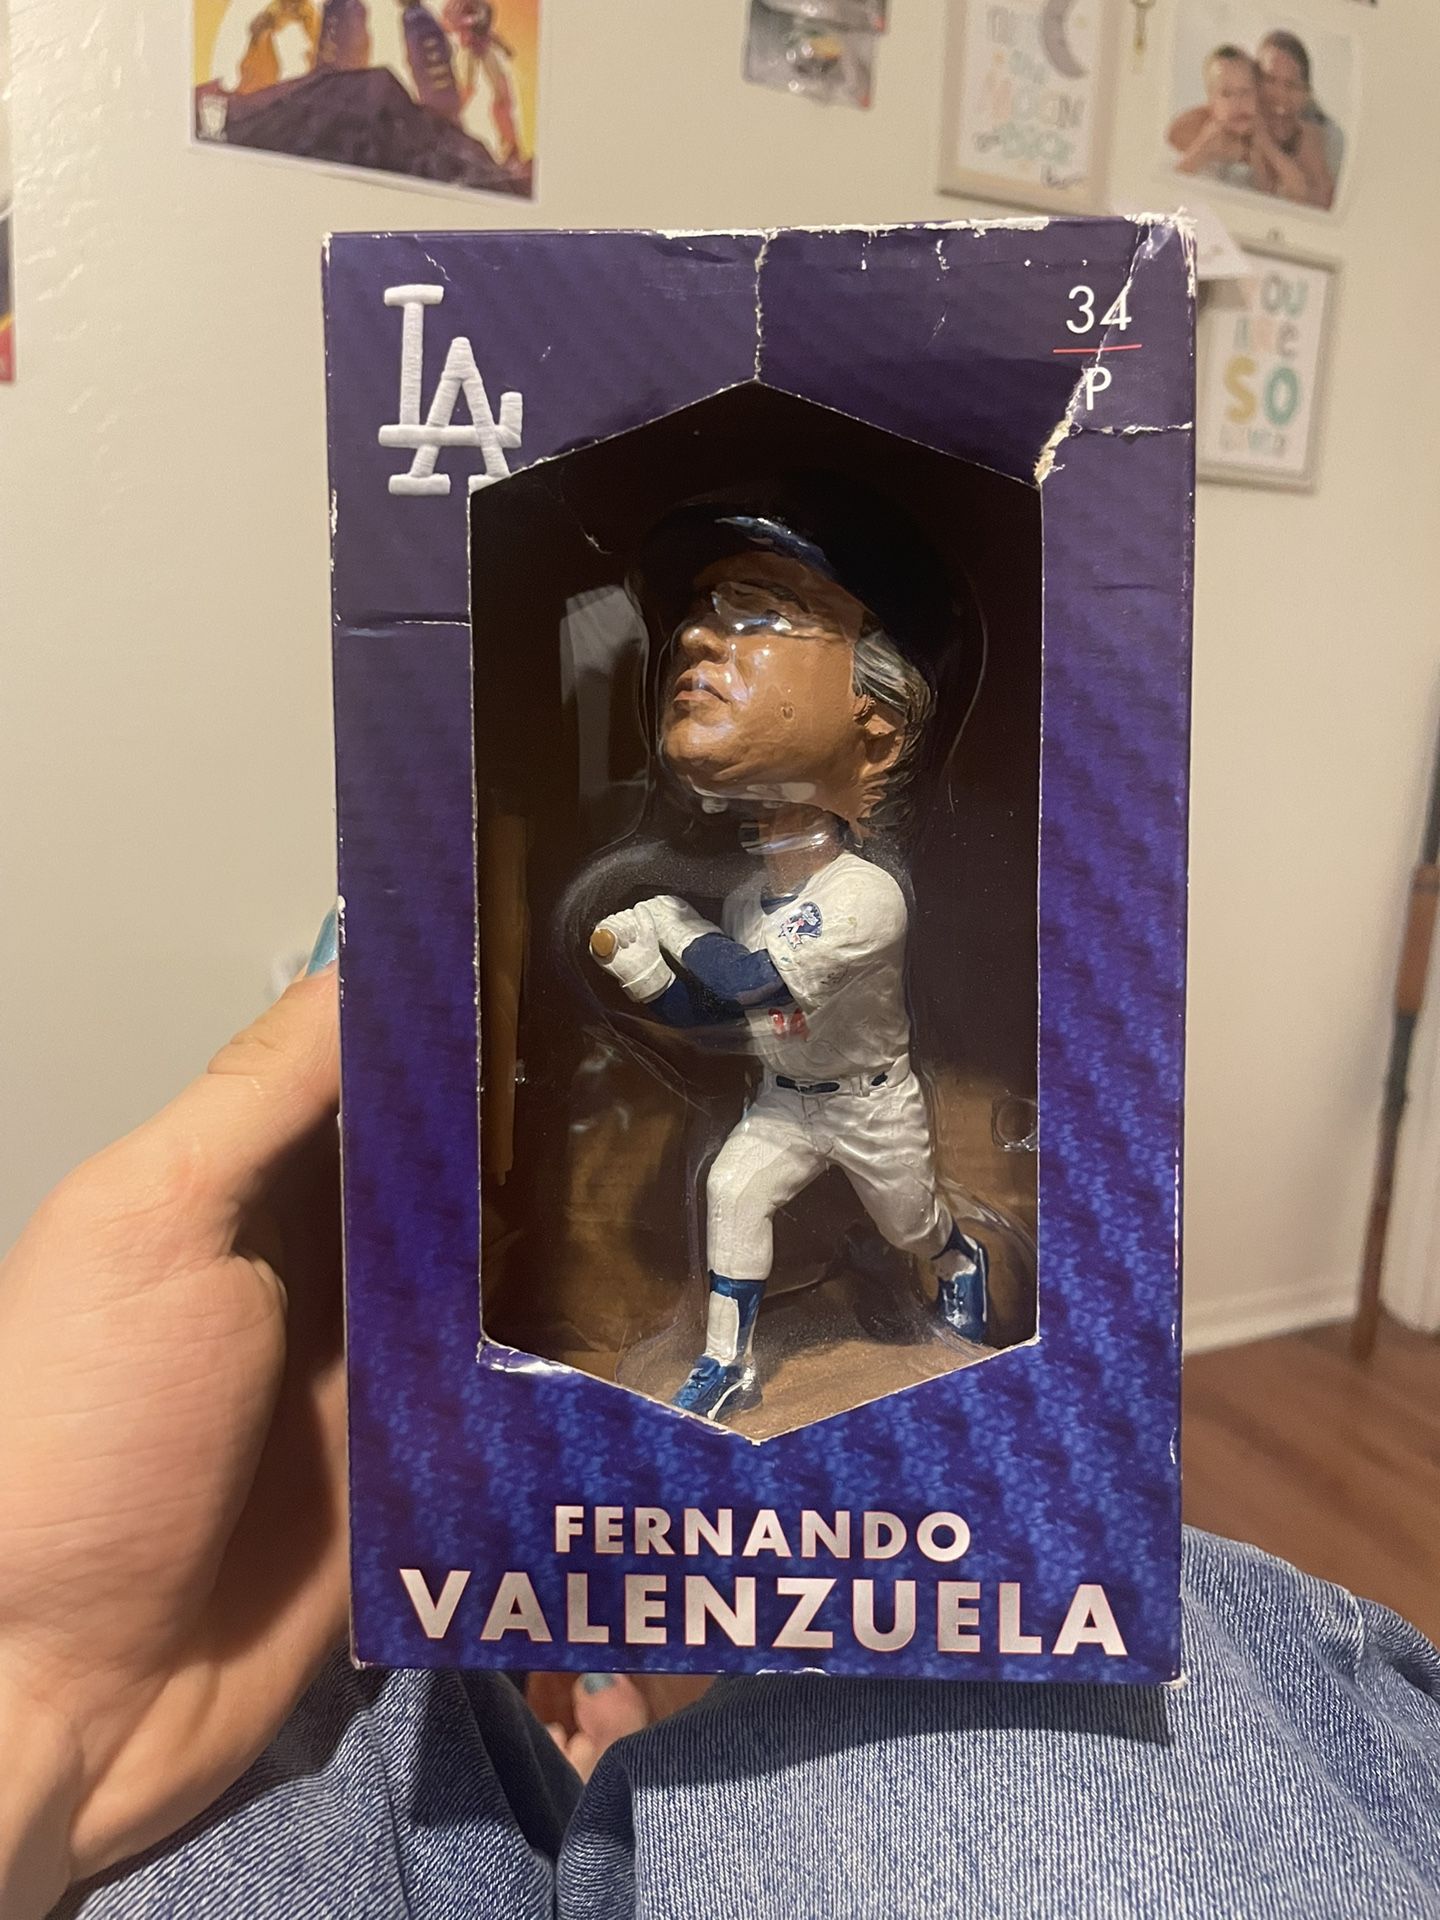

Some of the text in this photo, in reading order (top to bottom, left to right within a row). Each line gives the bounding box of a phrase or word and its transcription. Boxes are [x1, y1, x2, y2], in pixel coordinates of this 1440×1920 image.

[1066, 285, 1132, 333] 34
[1239, 270, 1309, 320] OU
[378, 284, 523, 496] LA
[1085, 366, 1112, 411] P
[1223, 354, 1299, 426] SO
[554, 1505, 971, 1563] FERNANDO
[400, 1568, 1128, 1656] VALENZUELA
